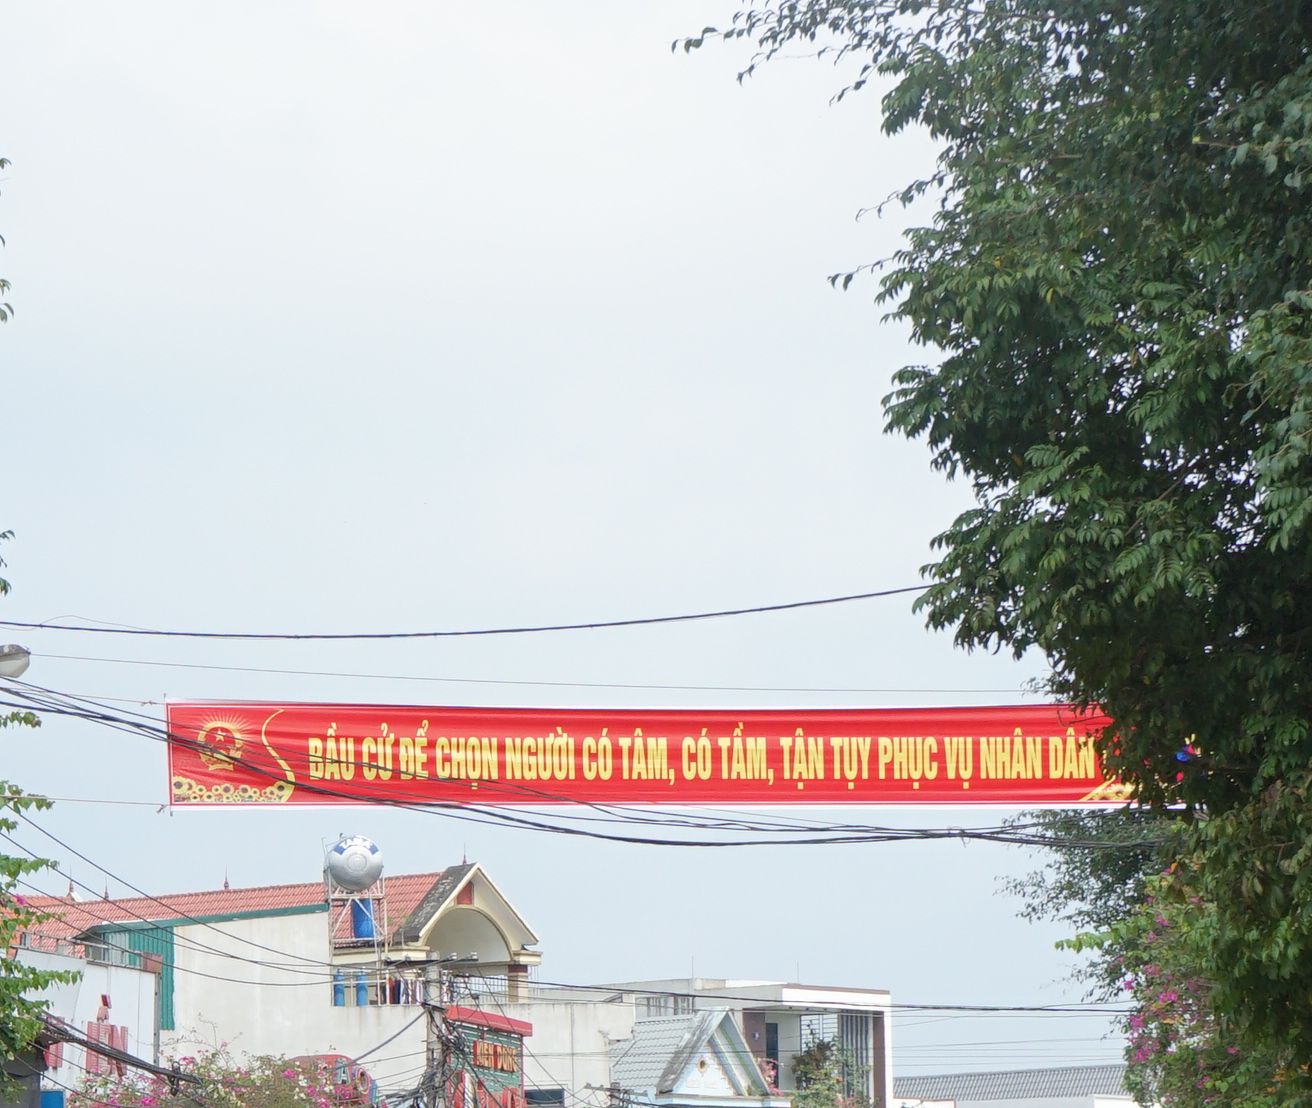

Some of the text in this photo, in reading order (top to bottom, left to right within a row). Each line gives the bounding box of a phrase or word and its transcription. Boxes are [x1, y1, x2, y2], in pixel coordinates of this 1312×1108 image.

[309, 719, 1095, 790] BẦU CỬ ĐỂ CHỌN NGƯỜI CÓ TÂM, CÓ TẦM, TẬN TỤY PHỤC VỤ NHÂN DÂN
